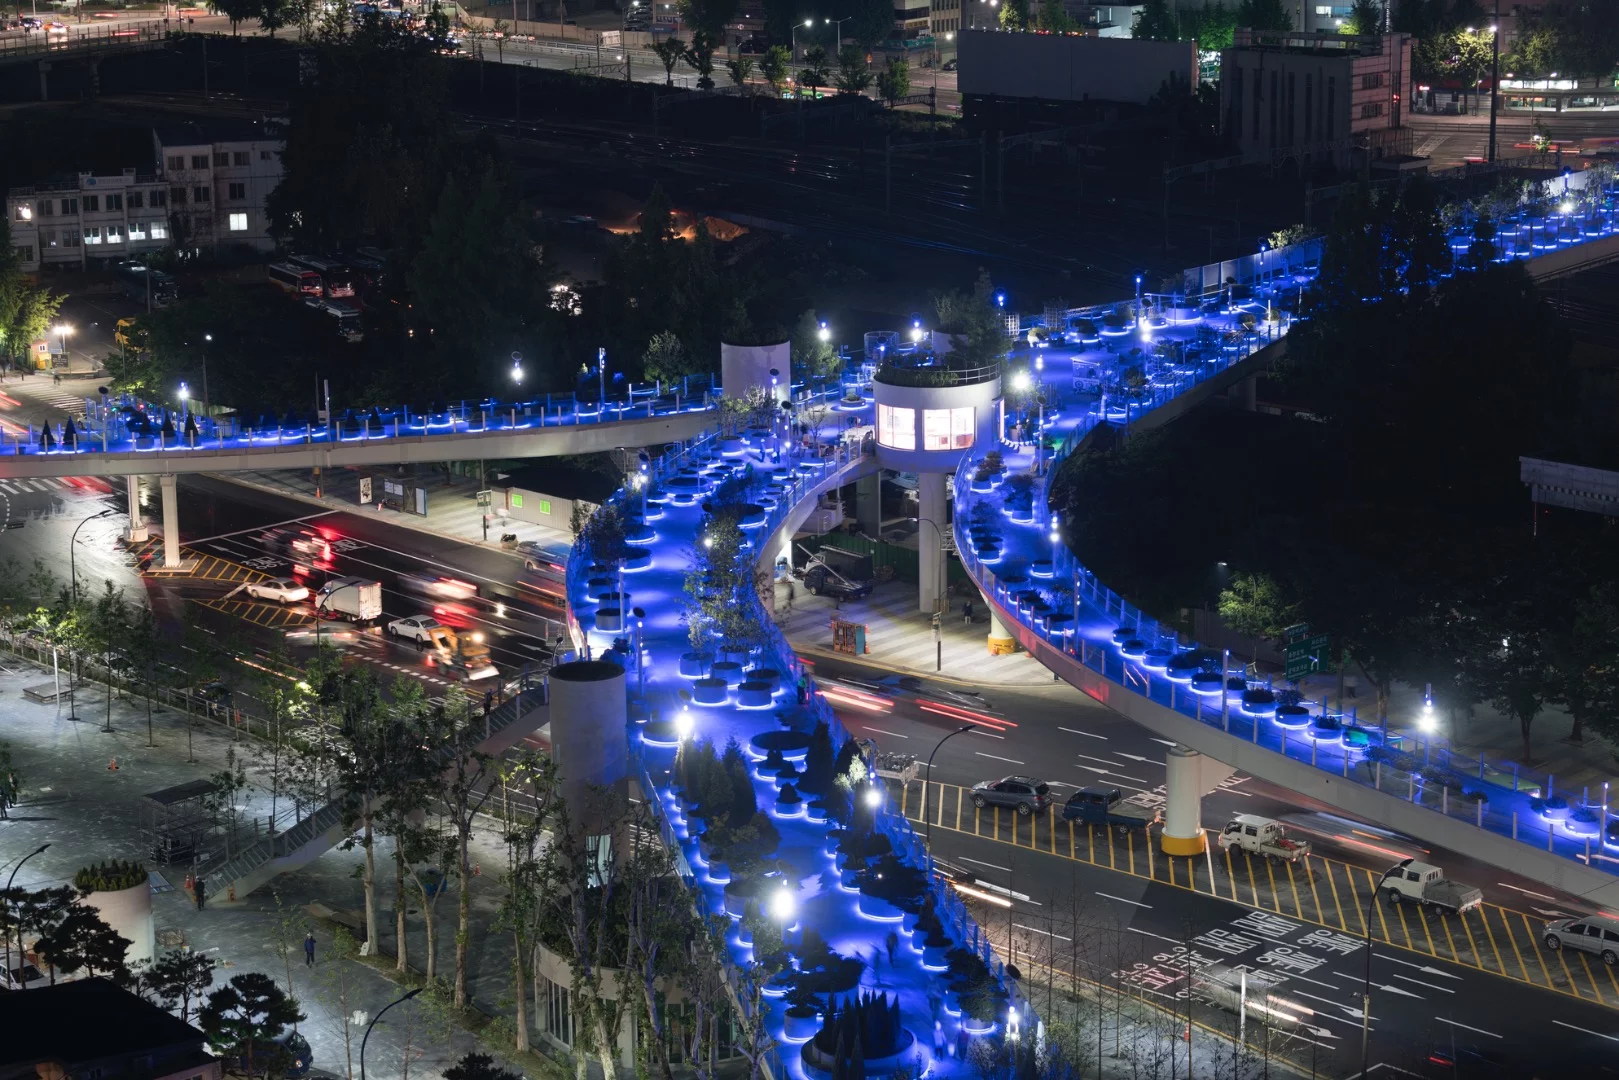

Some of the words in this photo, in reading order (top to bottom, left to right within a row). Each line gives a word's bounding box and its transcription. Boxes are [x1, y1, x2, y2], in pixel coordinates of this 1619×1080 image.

[1229, 911, 1302, 937] 삼거리
[1191, 929, 1262, 955] 삼거리
[1297, 930, 1366, 955] 청파동
[1256, 947, 1328, 974] 청파동
